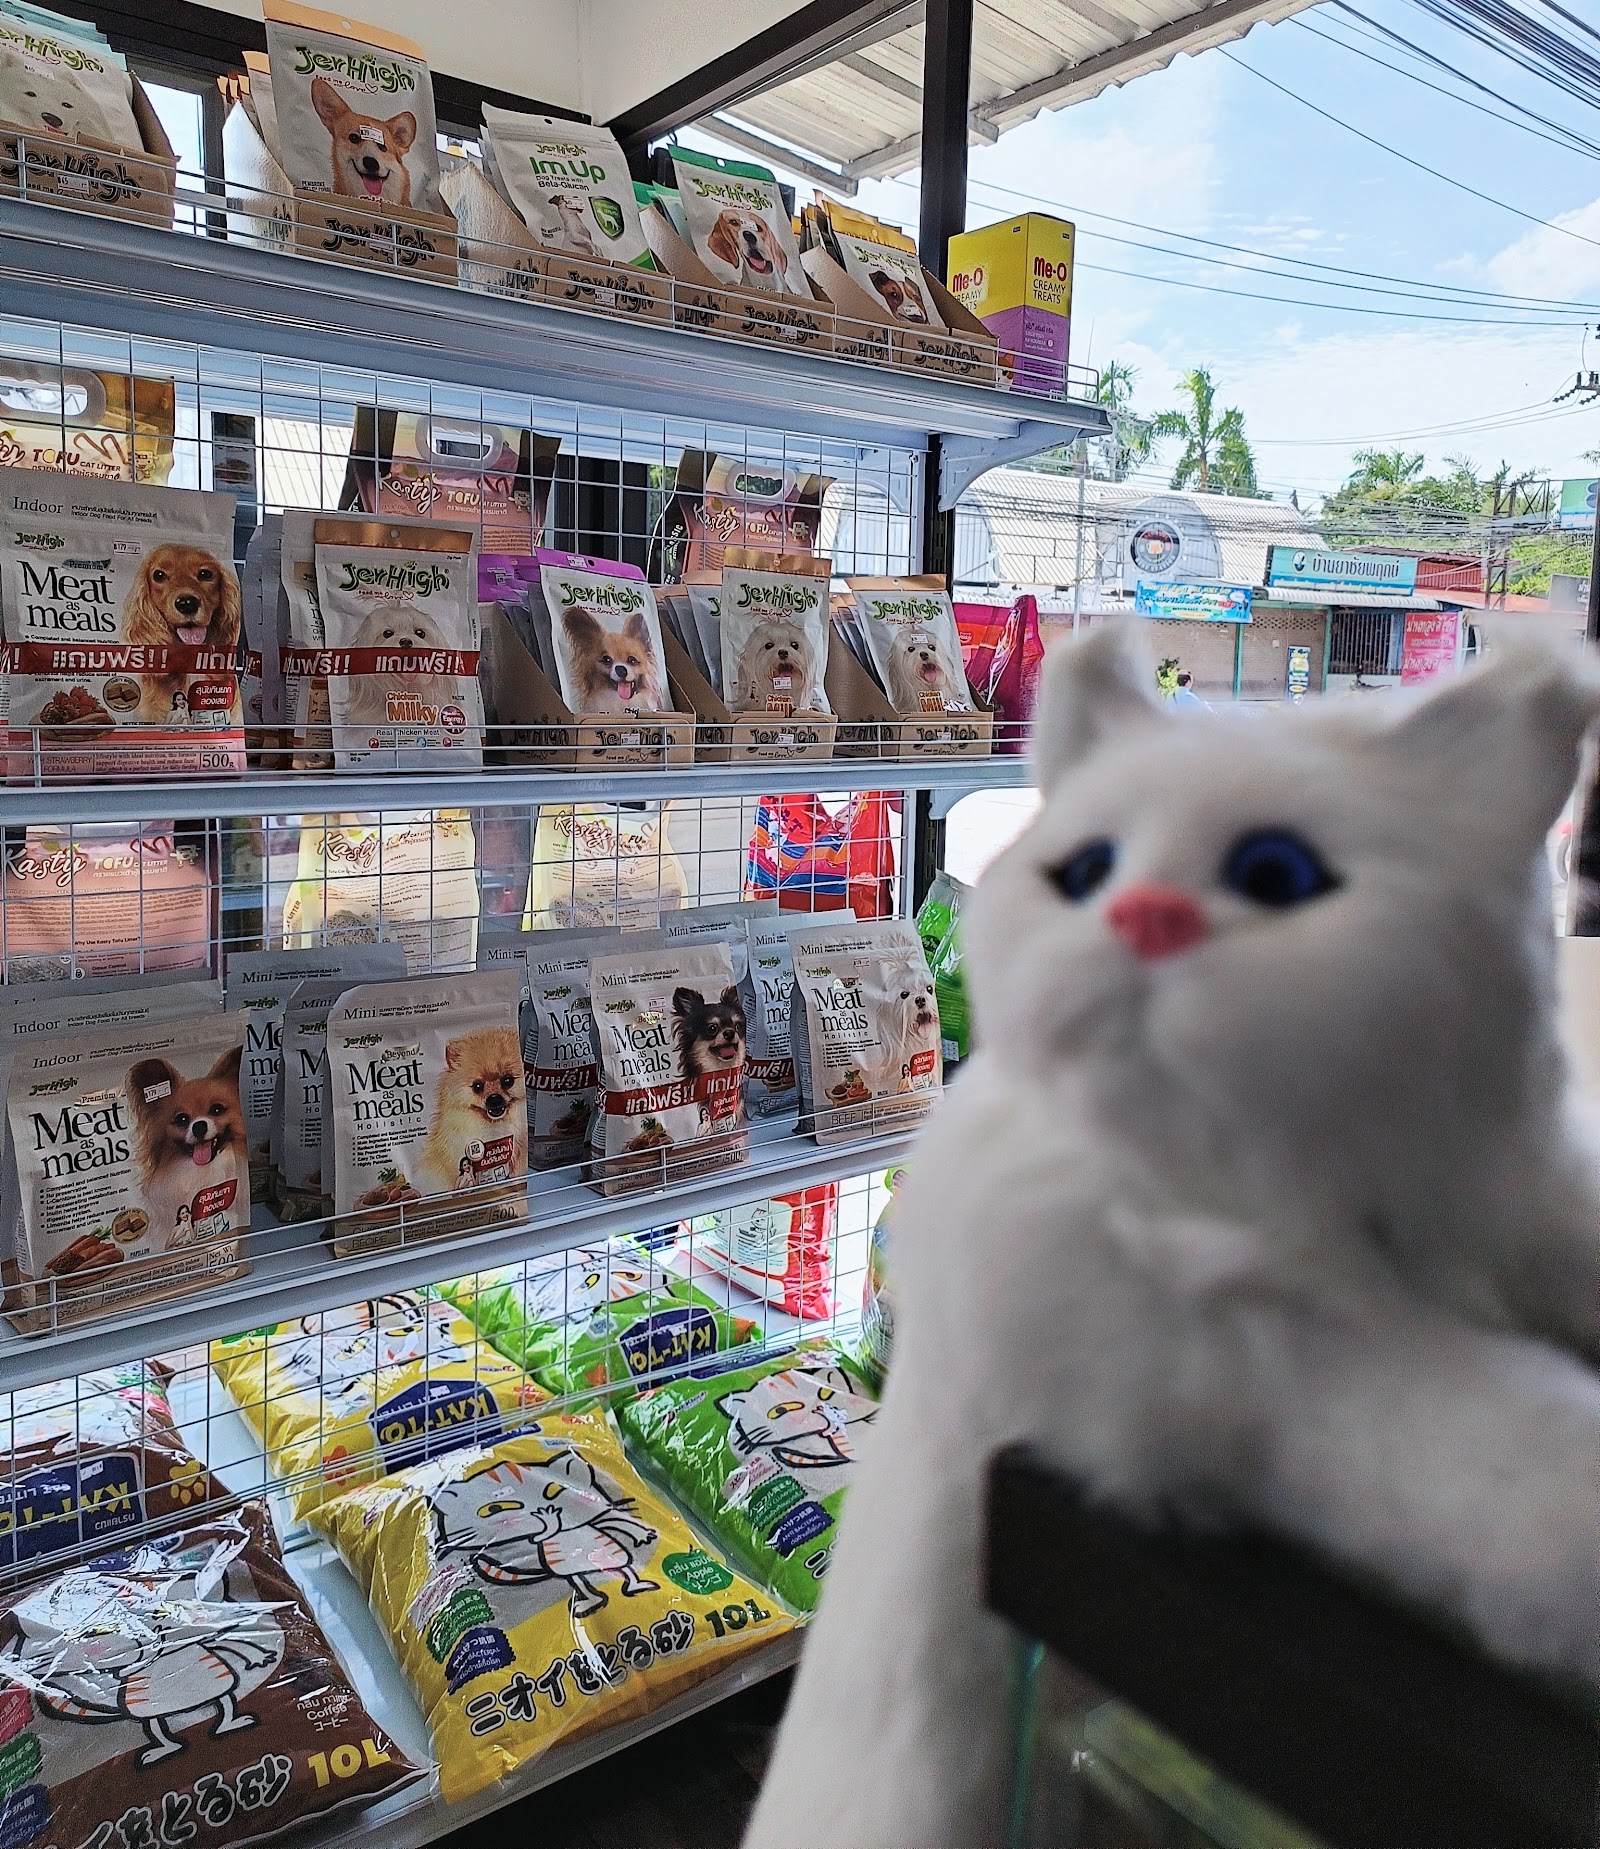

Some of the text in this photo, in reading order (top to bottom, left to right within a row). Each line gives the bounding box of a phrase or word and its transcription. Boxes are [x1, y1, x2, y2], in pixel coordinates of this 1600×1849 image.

[0, 28, 104, 73] erHigh
[294, 44, 415, 93] JerHigh
[536, 144, 587, 158] JerHigh
[569, 160, 606, 184] Up
[692, 178, 773, 210] JerHigh
[1033, 256, 1067, 282] Me-O
[953, 267, 984, 293] Me-O
[1033, 279, 1066, 294] CREAMY
[1033, 290, 1061, 304] TREATS
[33, 449, 80, 466] TOFU
[97, 463, 121, 472] LITTER
[378, 471, 442, 514] Kasty
[447, 491, 480, 505] TOFU
[13, 496, 64, 514] Indoor
[693, 502, 740, 542] Kasty
[15, 532, 65, 549] JerHigh
[16, 560, 115, 605] Meat
[339, 563, 450, 597] JerHigh
[66, 601, 80, 611] as
[559, 583, 645, 613] JerHigh
[737, 583, 818, 613] JerHigh
[26, 605, 117, 633] meals
[872, 599, 943, 621] JerHigh
[387, 691, 419, 701] Chicken
[386, 701, 438, 726] Milky
[46, 756, 92, 764] STRAWBERRY
[317, 831, 381, 868] Kasty
[6, 848, 87, 886] Kasty
[94, 857, 133, 870] TOFU
[668, 925, 690, 937] Mini
[756, 933, 776, 946] Mini
[488, 949, 512, 961] Mini
[800, 943, 824, 956] Mini
[243, 970, 273, 984] Mini
[537, 963, 563, 975] Mini
[601, 973, 627, 987] Mini
[301, 999, 333, 1009] Mini
[605, 999, 636, 1013] JerHigh
[811, 988, 866, 1012] Meat
[343, 1006, 377, 1020] Mini
[820, 1012, 869, 1033] meals
[13, 1020, 60, 1035] Indoor
[547, 1010, 592, 1040] Mea
[343, 1033, 384, 1049] JerHigh
[610, 1025, 670, 1055] Meat
[32, 1052, 83, 1069] Indoor
[386, 1049, 416, 1060] Beyond
[553, 1041, 594, 1061] mea
[637, 1050, 647, 1058] as
[621, 1052, 672, 1078] meals
[29, 1076, 79, 1096] JerHigh
[345, 1059, 425, 1096] Meat
[81, 1092, 116, 1104] Premium
[382, 1089, 395, 1099] as
[353, 1090, 425, 1122] meals
[29, 1102, 128, 1151] Meat
[357, 1117, 422, 1131] Holistic
[831, 1111, 856, 1125] BEEF
[80, 1137, 95, 1149] as
[40, 1137, 130, 1180] meals
[352, 1235, 387, 1248] RECIPE
[629, 1324, 711, 1372] KAT-TO
[380, 1393, 490, 1443] KAT-TO
[794, 1514, 820, 1534] BACTERIAL
[685, 1566, 714, 1582] Apple
[705, 1599, 771, 1638] 10L
[306, 1702, 348, 1721] Coffee
[313, 1716, 349, 1732] コーヒー
[308, 1738, 390, 1788] 10L
